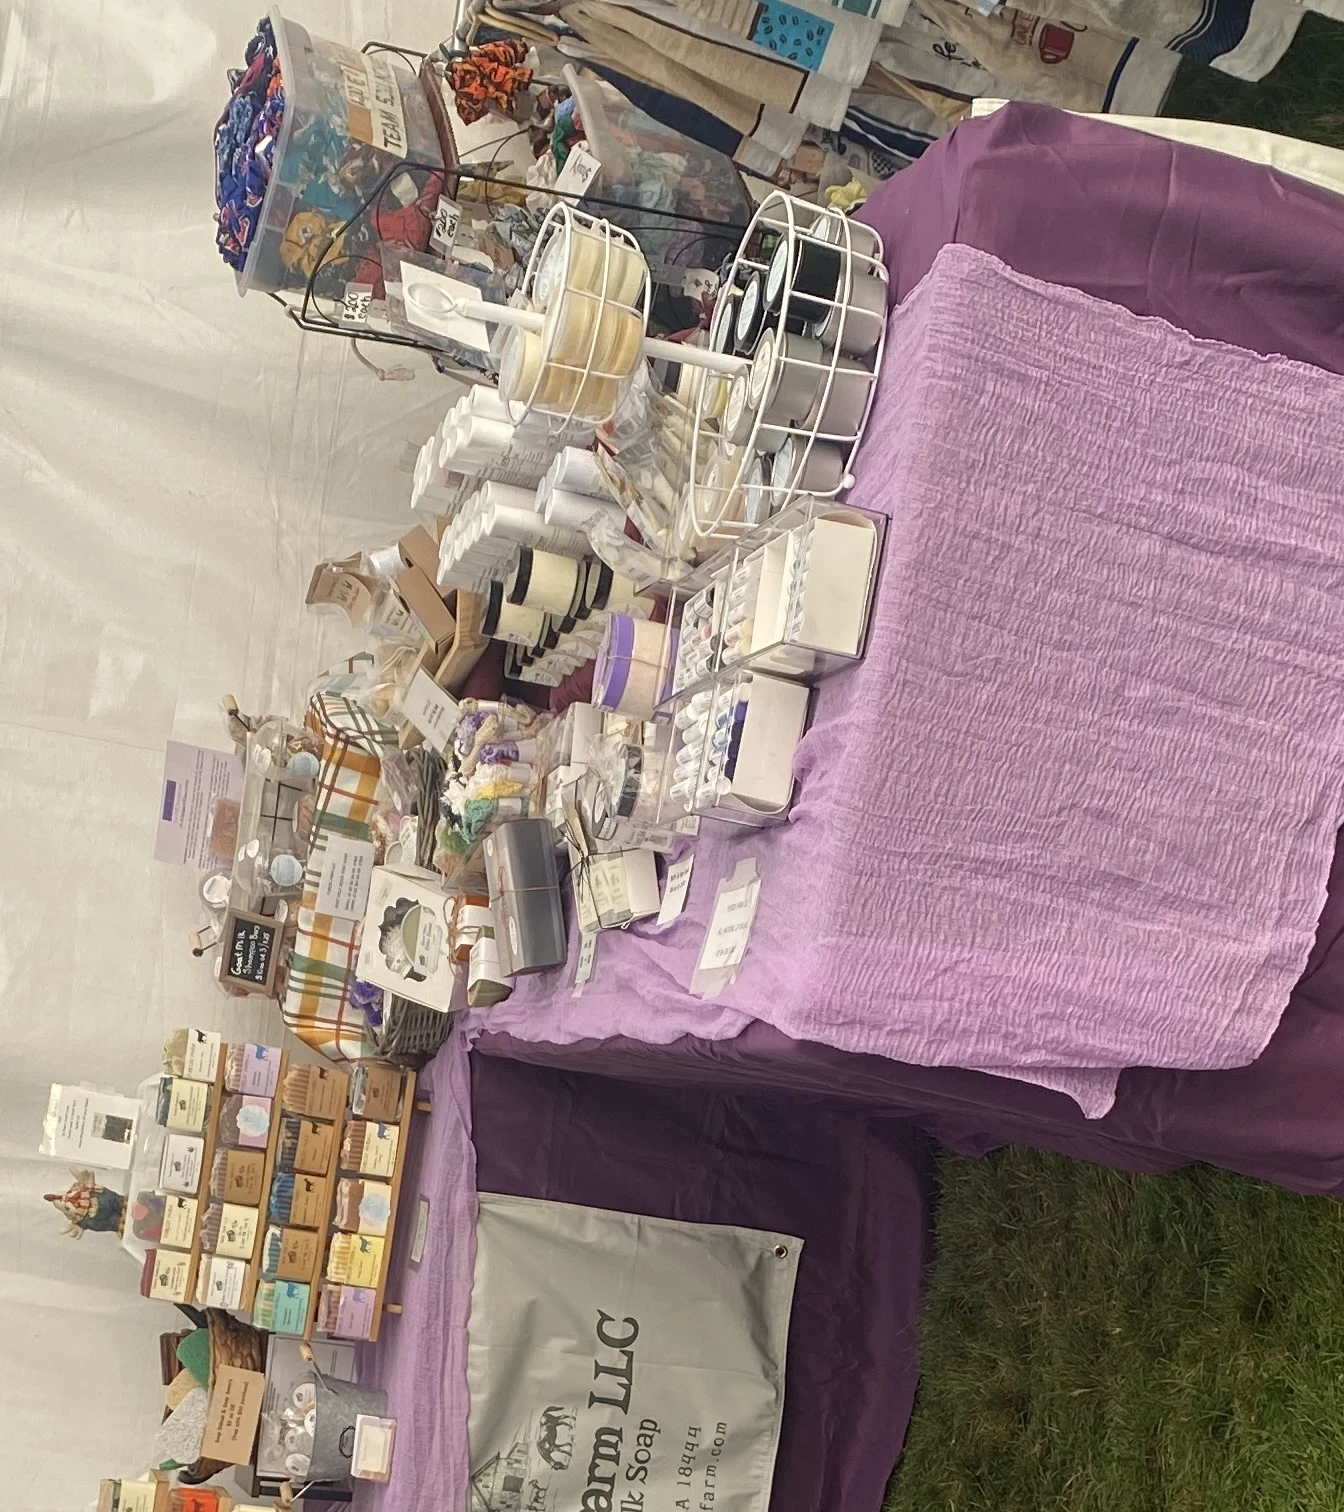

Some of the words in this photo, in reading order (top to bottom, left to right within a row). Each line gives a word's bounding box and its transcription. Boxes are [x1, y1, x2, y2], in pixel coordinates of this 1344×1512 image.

[378, 108, 402, 148] TEAM
[447, 214, 460, 238] each
[358, 296, 371, 320] each
[230, 952, 243, 976] Goat
[588, 1308, 640, 1415] LLC
[625, 1418, 662, 1486] Soap
[676, 1424, 702, 1487] 18444
